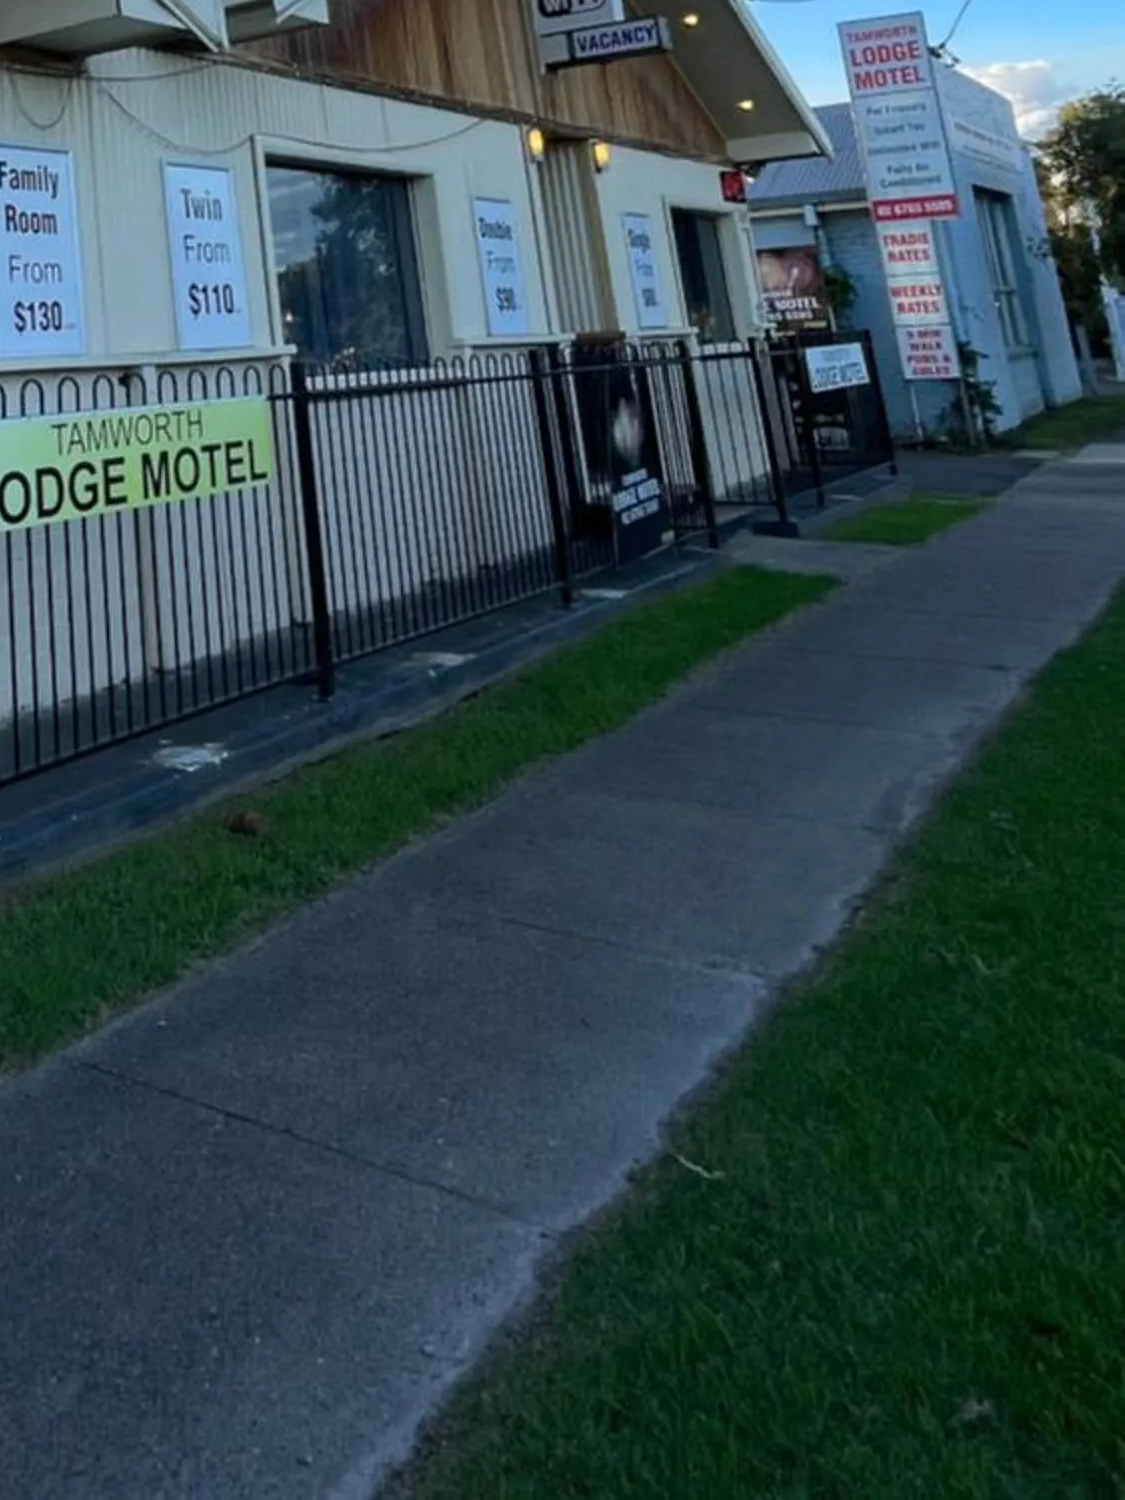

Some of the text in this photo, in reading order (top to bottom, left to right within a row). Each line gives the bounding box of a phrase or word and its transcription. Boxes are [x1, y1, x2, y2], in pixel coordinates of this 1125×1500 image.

[576, 25, 656, 52] VACANCY
[849, 39, 923, 67] LODGE
[853, 66, 927, 89] MOTEL
[180, 188, 223, 221] Twin
[4, 204, 58, 235] Room
[183, 235, 231, 263] From
[883, 232, 930, 248] TRADIE
[8, 255, 63, 284] From
[888, 249, 931, 262] RATES
[188, 283, 234, 319] $110
[890, 284, 942, 298] WEEKLY
[14, 300, 63, 336] $130
[897, 301, 940, 314] RATES
[51, 408, 204, 455] TAMWORTH
[140, 439, 268, 500] MOTEL
